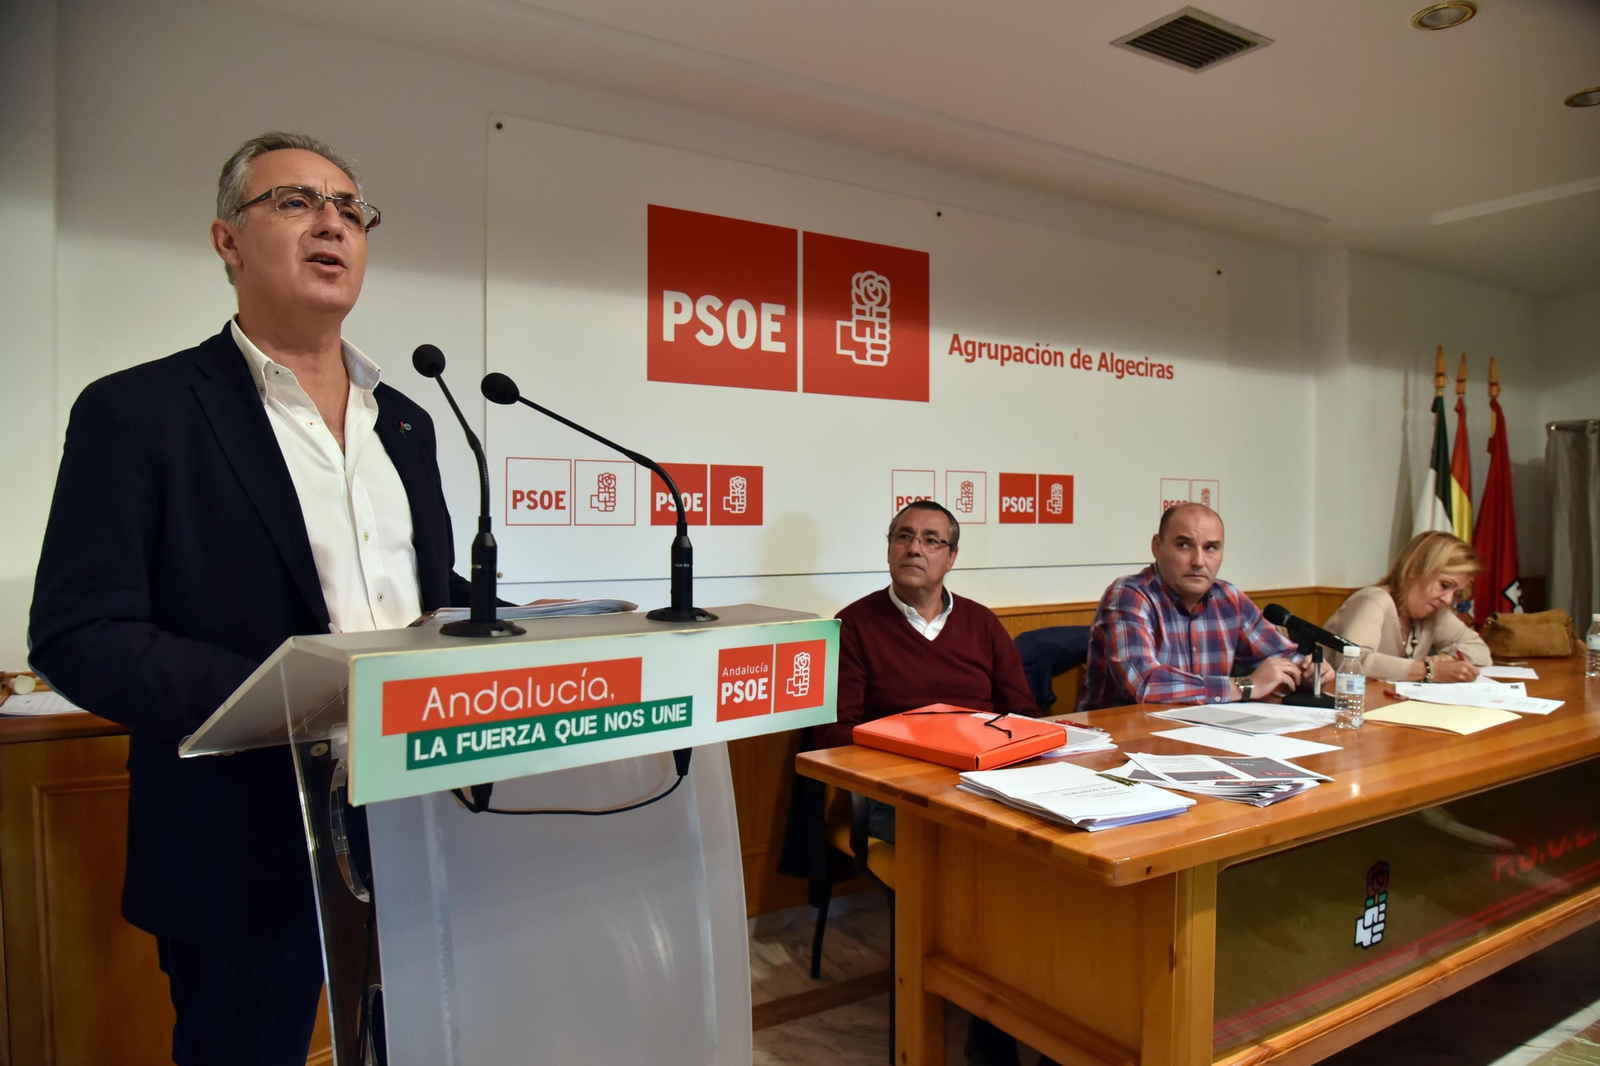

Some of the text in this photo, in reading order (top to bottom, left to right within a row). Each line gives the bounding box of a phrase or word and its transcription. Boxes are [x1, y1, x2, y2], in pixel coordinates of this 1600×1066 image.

[663, 290, 786, 352] PSOE
[948, 333, 1174, 379] Agrupación de Algeciras
[512, 489, 566, 510] PSOE
[656, 491, 703, 512] PSOE
[1002, 496, 1034, 513] PSOE
[721, 662, 769, 678] Andalucía
[421, 667, 615, 721] Andalucía,
[721, 677, 769, 706] PSOE
[414, 702, 687, 761] LA FUERZA QUE NOS UNE
